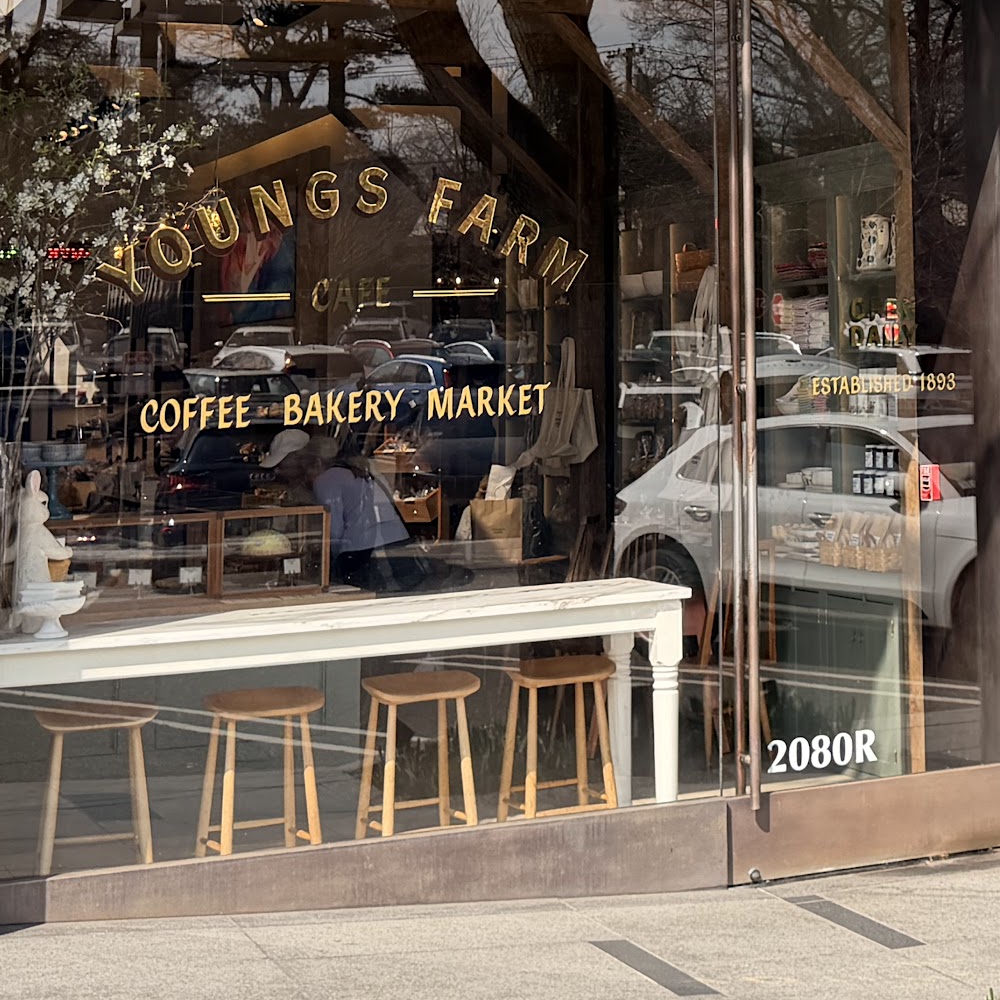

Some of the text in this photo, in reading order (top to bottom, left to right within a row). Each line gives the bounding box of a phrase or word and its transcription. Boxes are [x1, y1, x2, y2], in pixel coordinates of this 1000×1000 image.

[96, 166, 589, 298] YOUNGS FARM
[311, 275, 392, 314] CAFE
[811, 371, 956, 397] ESTABLISHED 1893
[140, 393, 251, 434] COFFEE
[283, 388, 405, 427] BAKERY
[427, 381, 552, 421] MARKET
[767, 728, 878, 774] 2080R
